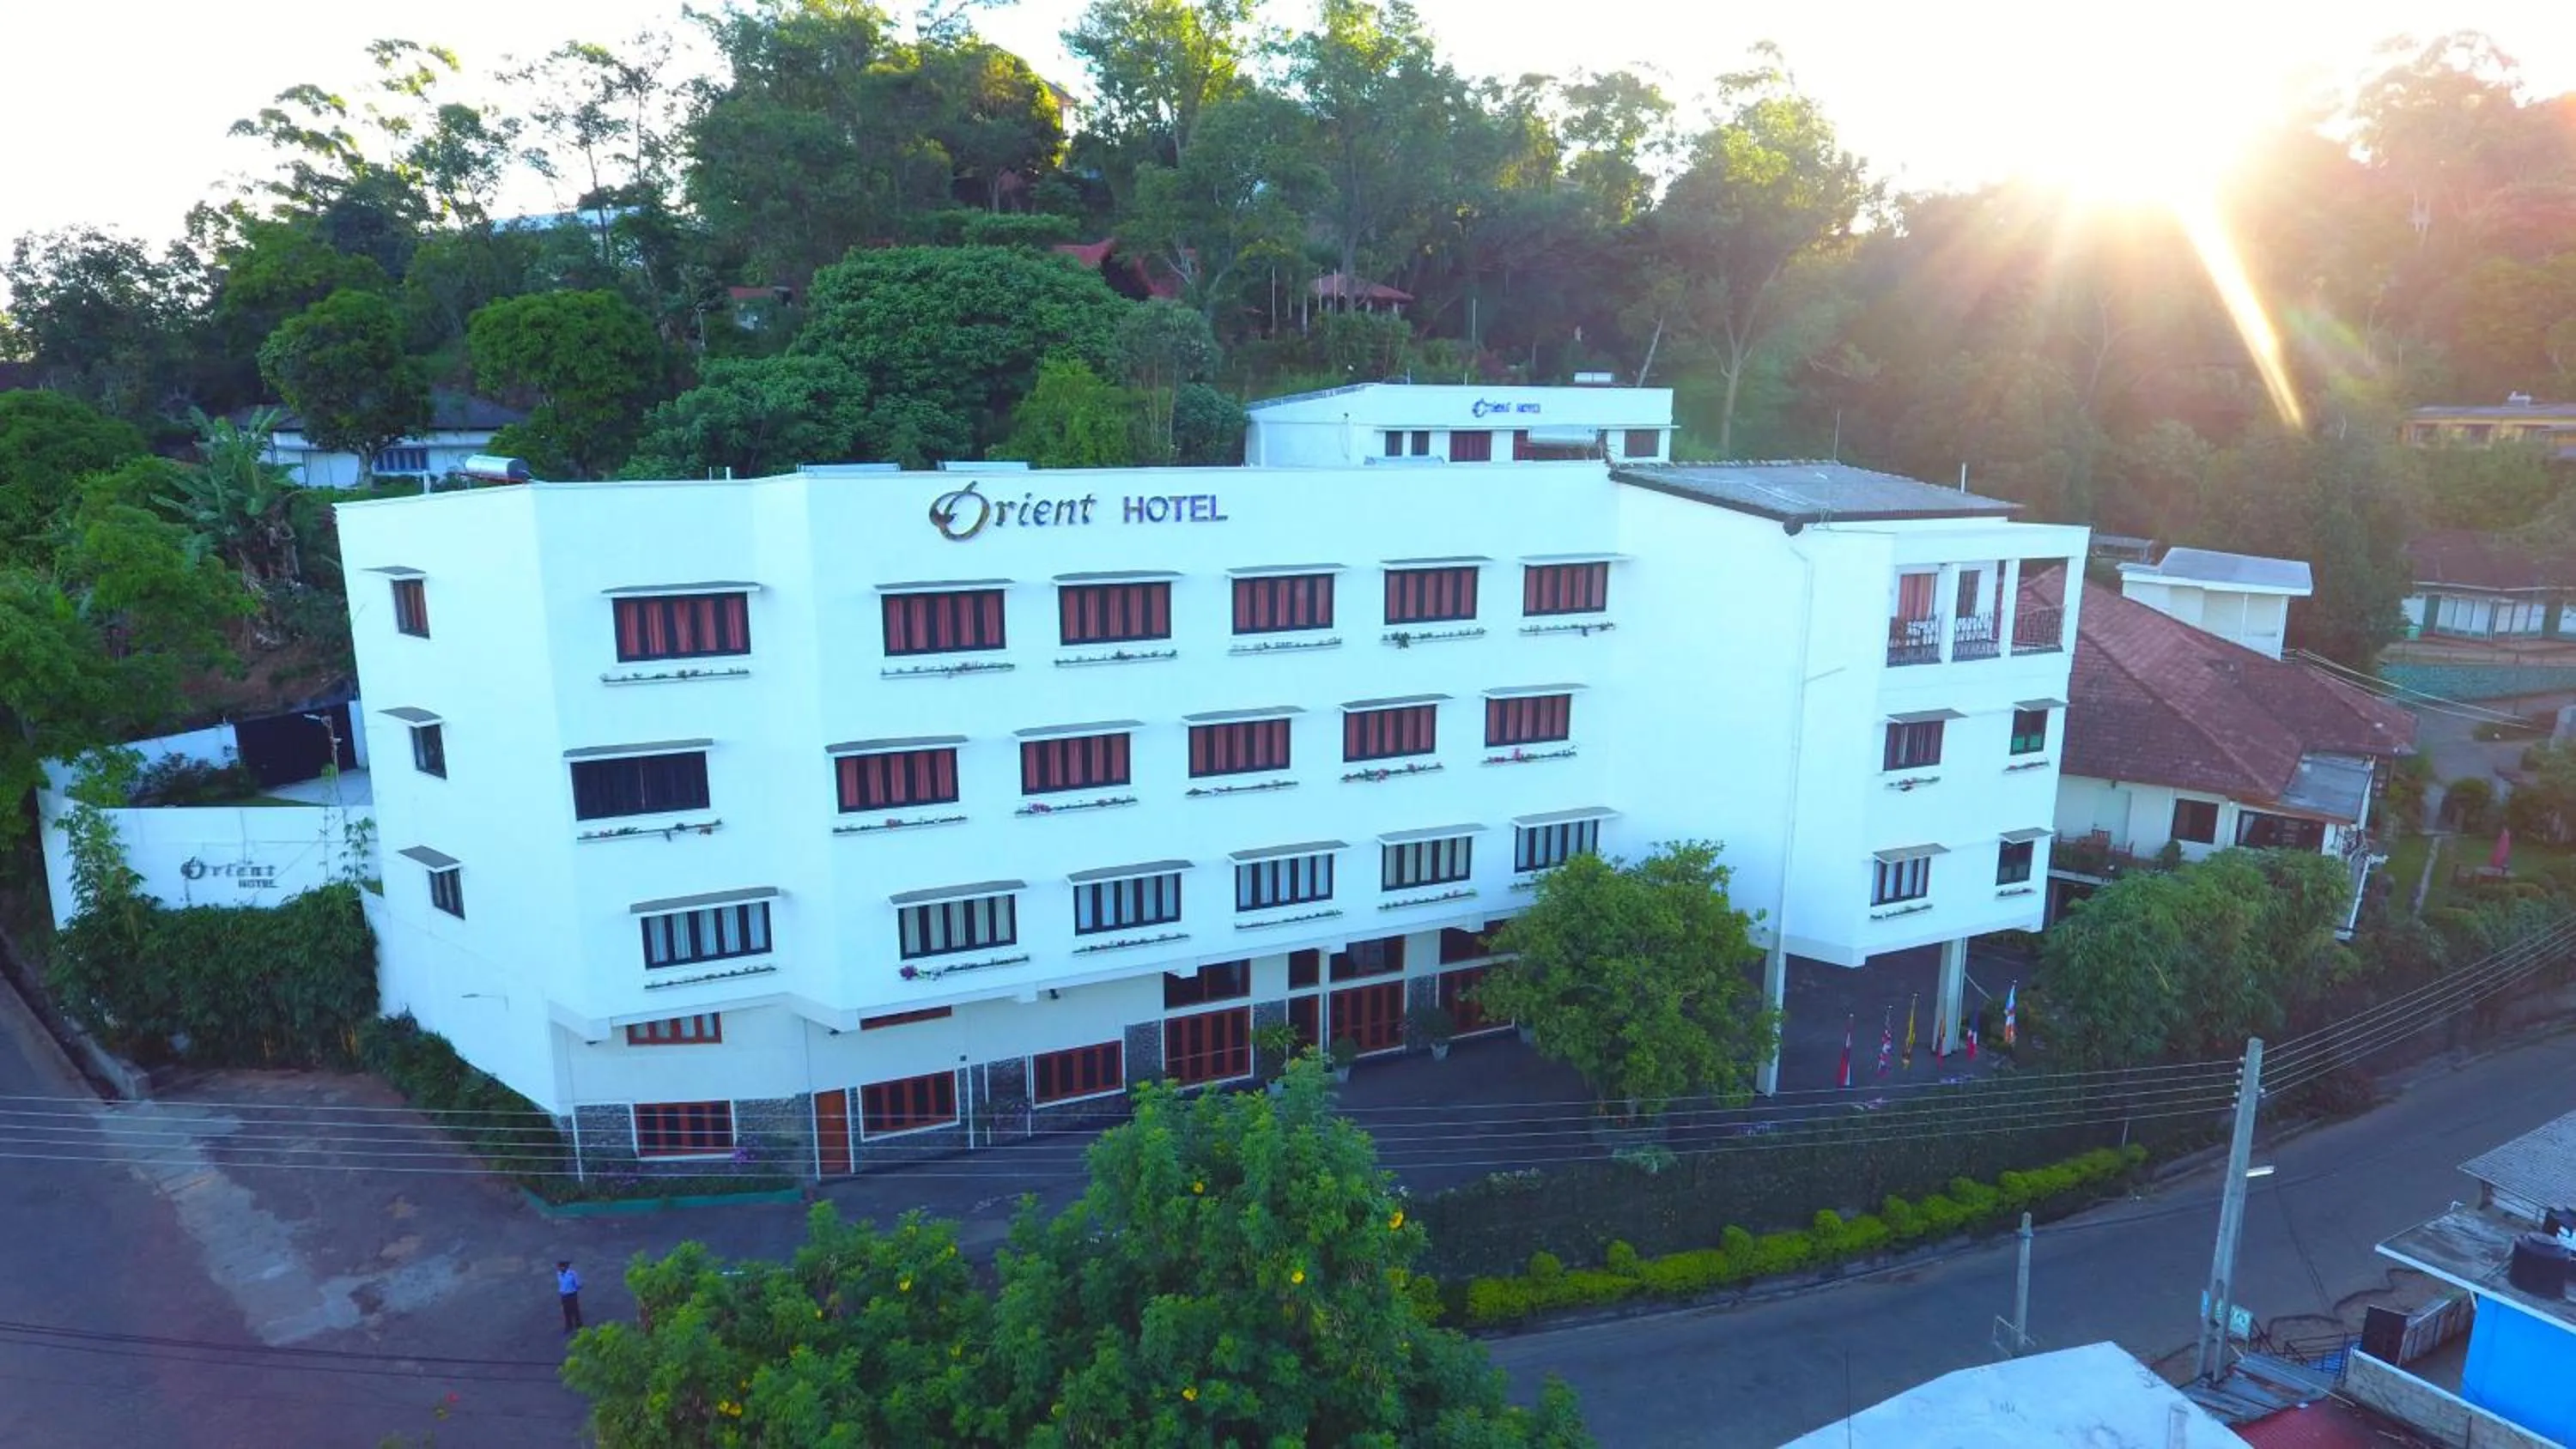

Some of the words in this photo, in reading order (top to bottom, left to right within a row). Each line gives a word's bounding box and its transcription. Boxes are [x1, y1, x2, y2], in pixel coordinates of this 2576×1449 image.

[928, 480, 1097, 541] Orient
[1122, 494, 1228, 524] HOTEL
[179, 856, 276, 880] Orient
